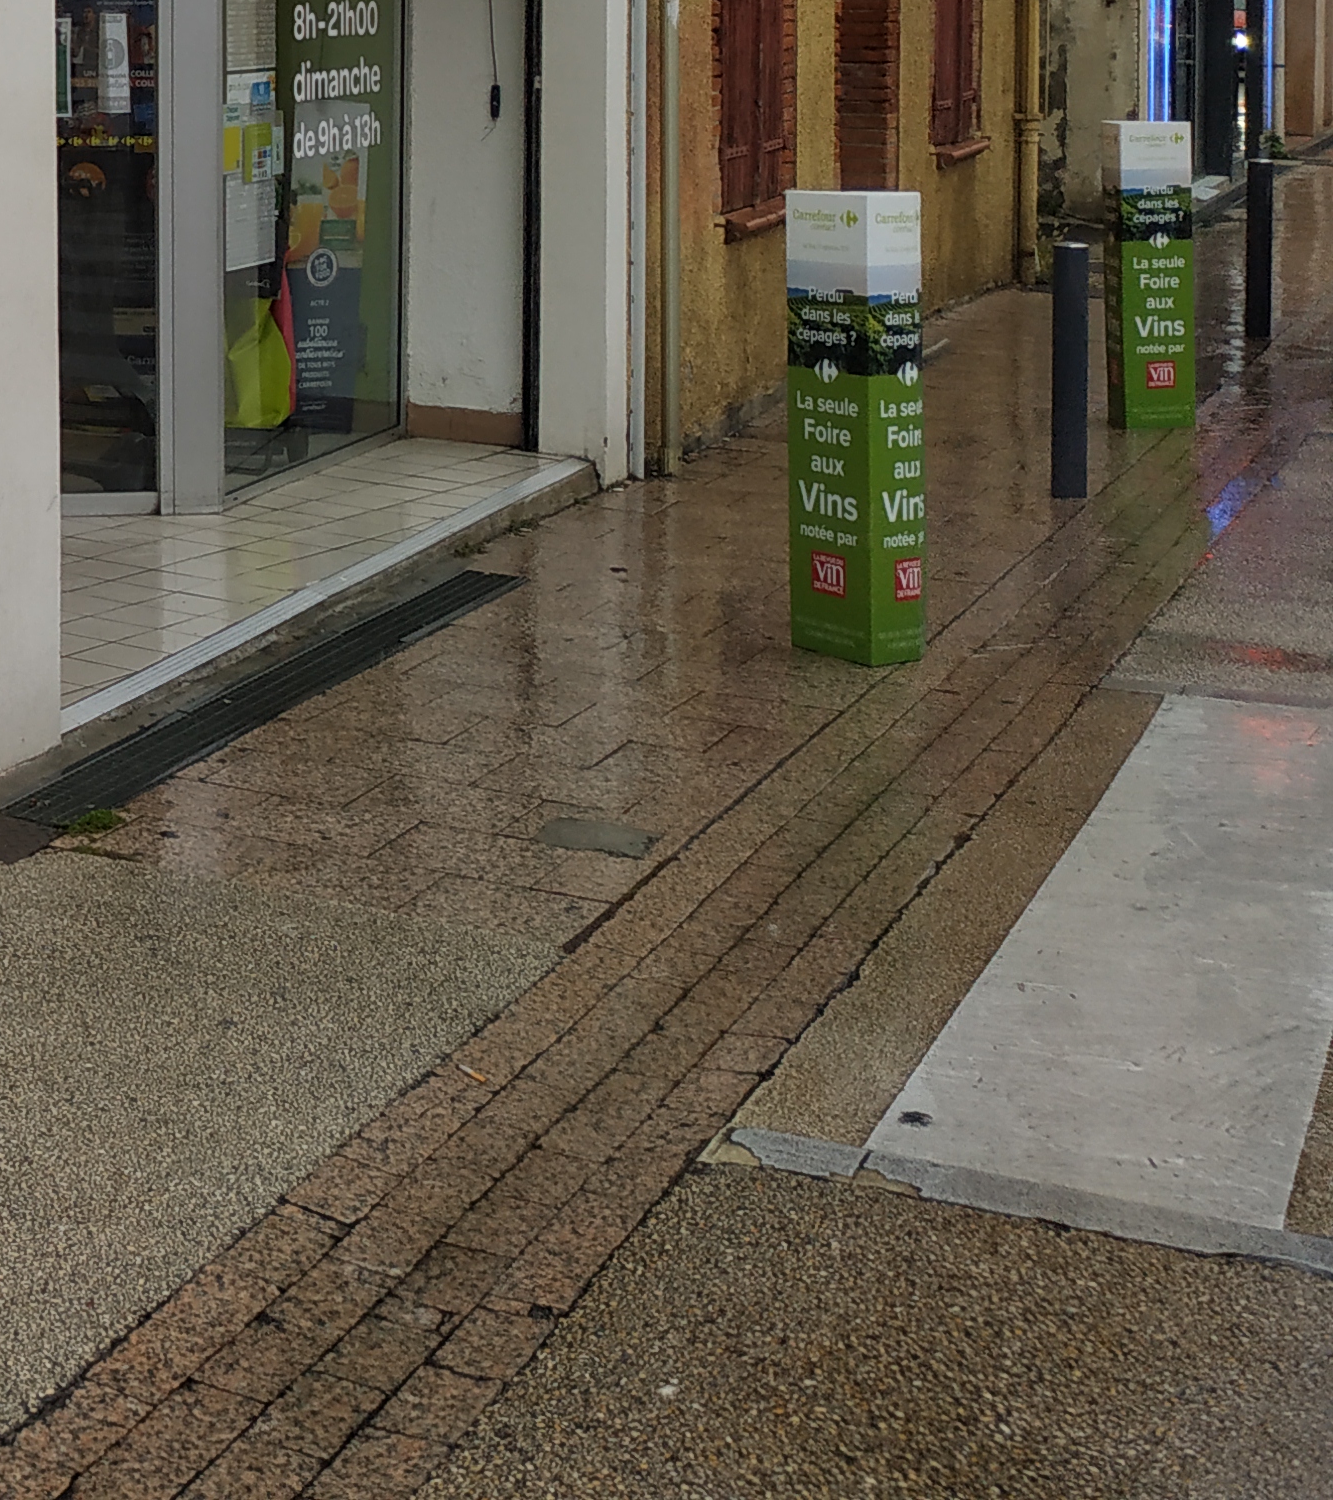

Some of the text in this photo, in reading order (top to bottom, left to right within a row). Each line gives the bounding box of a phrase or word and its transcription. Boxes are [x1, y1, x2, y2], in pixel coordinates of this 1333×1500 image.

[294, 56, 381, 102] dimanche
[294, 111, 381, 158] de 9h à 13h
[1143, 185, 1173, 195] Perdu
[1137, 198, 1179, 208] dans les
[1133, 255, 1185, 269] La seule
[1139, 273, 1180, 289] Foire
[807, 286, 844, 303] Perdu
[891, 288, 919, 304] Perd
[1146, 296, 1174, 309] aux
[801, 306, 851, 325] dans les
[885, 311, 912, 326] dans
[309, 326, 328, 337] 100
[1135, 315, 1185, 338] Vins
[796, 327, 847, 347] cépages
[1136, 342, 1185, 355] notée par
[796, 391, 859, 418] La seule
[880, 400, 897, 418] La
[803, 418, 851, 447] Foire
[810, 454, 845, 476] aux
[798, 479, 858, 522] Vins
[800, 522, 857, 547] notée par
[883, 530, 916, 548] notée
